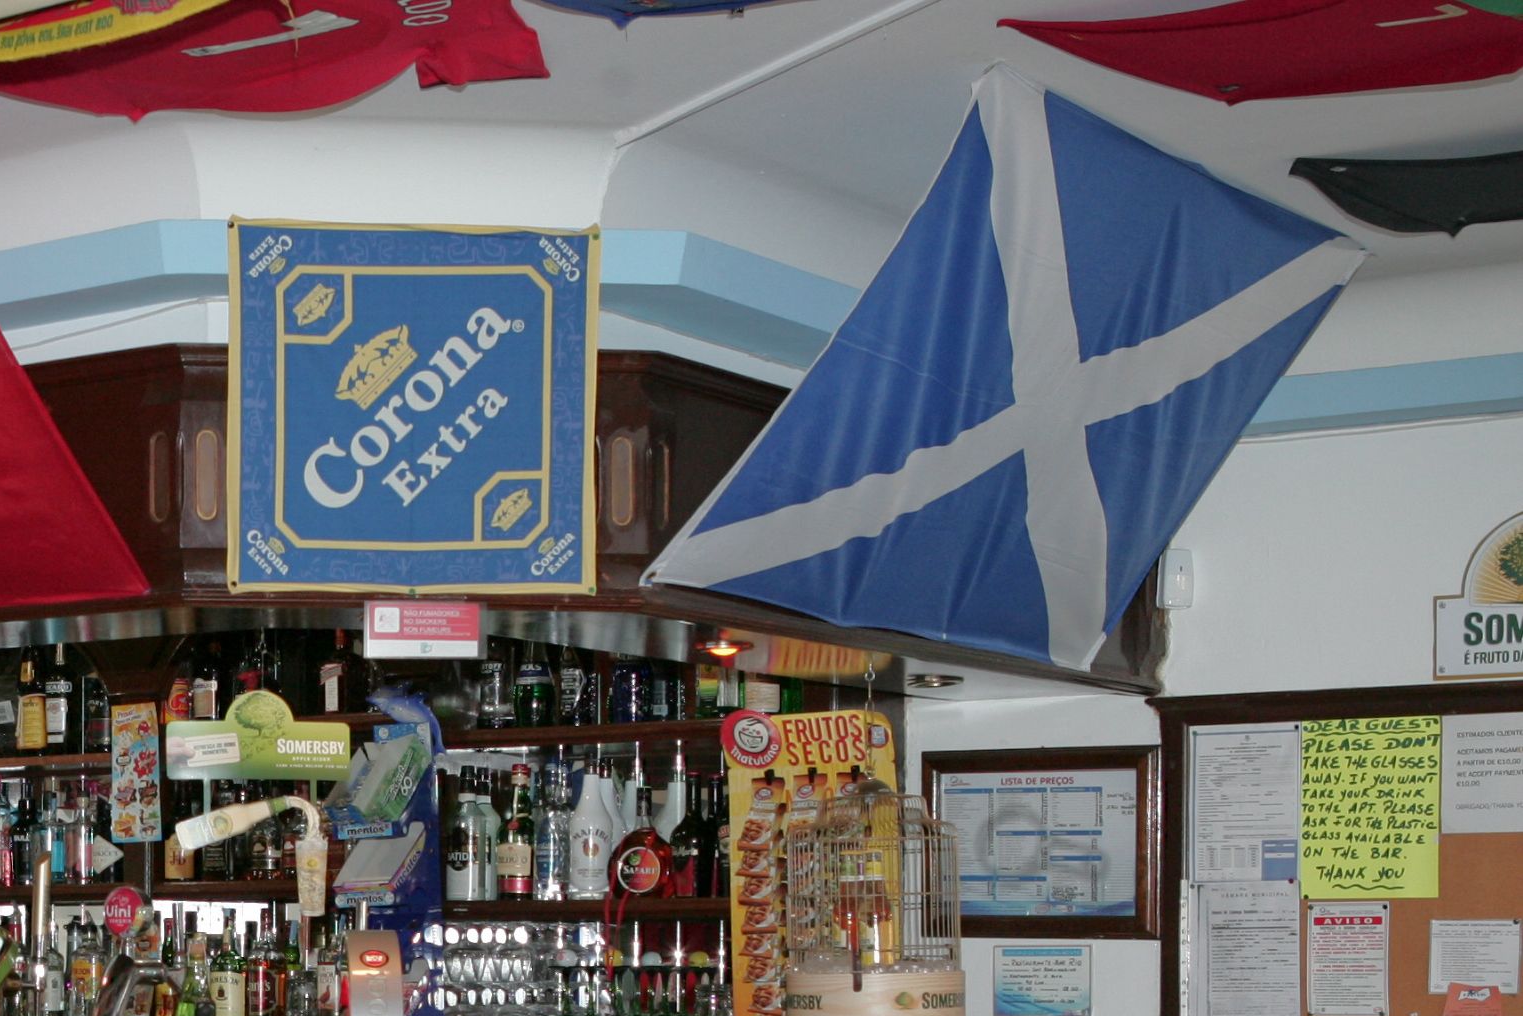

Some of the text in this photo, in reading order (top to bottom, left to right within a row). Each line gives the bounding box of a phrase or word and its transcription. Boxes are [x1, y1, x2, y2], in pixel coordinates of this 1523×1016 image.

[249, 235, 292, 278] Corona
[539, 236, 580, 282] Corona
[304, 306, 511, 509] Corona
[381, 387, 508, 507] Extra
[247, 529, 289, 576] Corona
[531, 532, 575, 576] Corona
[1464, 649, 1470, 665] É
[1473, 651, 1510, 664] FRUTO
[781, 713, 863, 743] FRUTOS
[1307, 718, 1439, 733] DEAR GUEST
[785, 737, 866, 766] SECOS
[1302, 734, 1441, 753] PLEASE DON'T
[1302, 755, 1438, 770] TAKE THE GLASSES
[1000, 776, 1075, 787] LISTA DE PREÇOS
[1349, 772, 1367, 785] IF
[1367, 773, 1394, 790] YOU
[1398, 772, 1438, 784] WANT
[1302, 787, 1425, 802] TAKE YOUR DRINK
[1302, 803, 1315, 813] TO
[1318, 801, 1341, 814] THE
[1383, 800, 1435, 815] PLEASE
[346, 826, 385, 837] mentos
[1302, 815, 1437, 830] ASK FOR THE PLASTIC
[1302, 831, 1426, 844] GLASS AVAILABLE
[1303, 846, 1324, 858] ON
[1332, 845, 1359, 860] THE
[1316, 864, 1405, 882] THANK YOU
